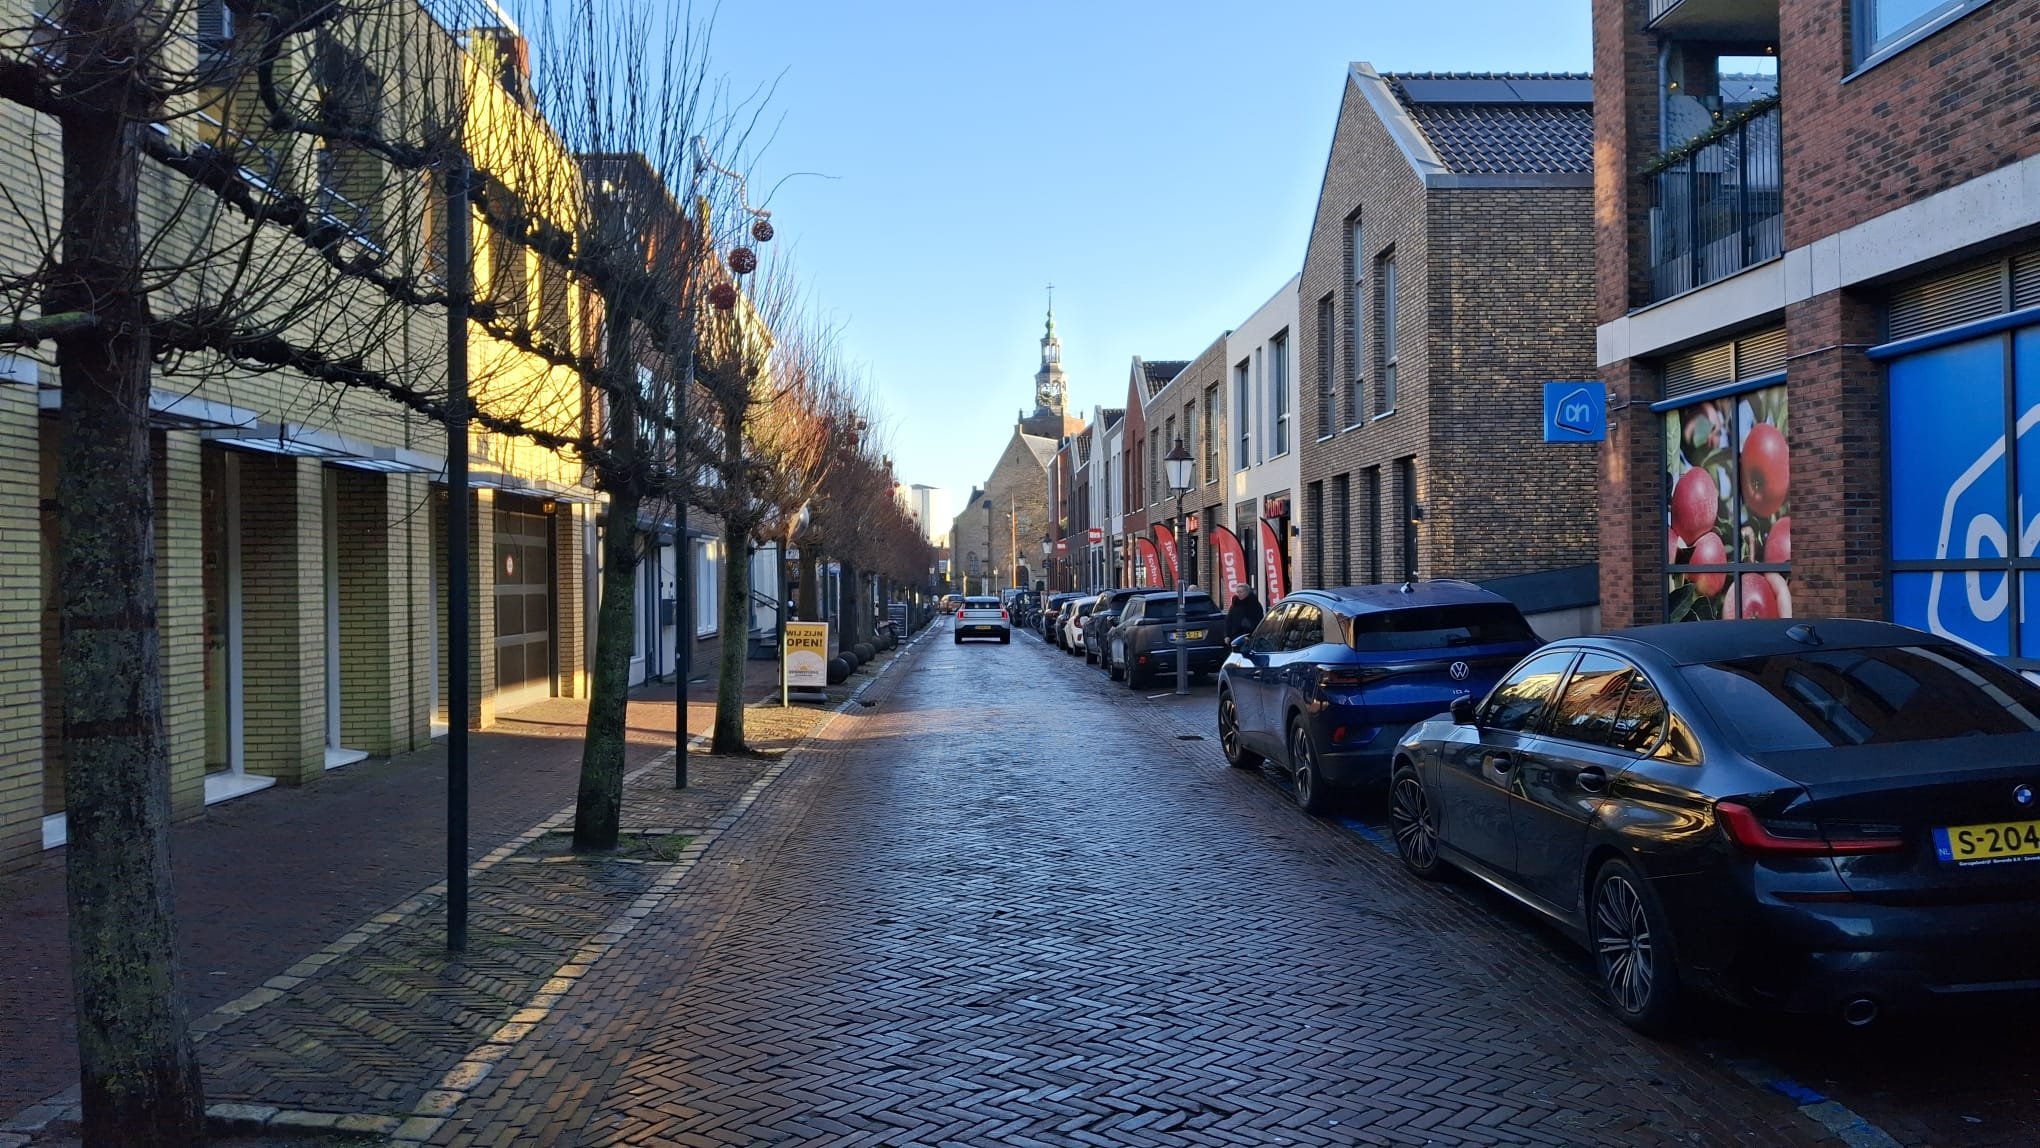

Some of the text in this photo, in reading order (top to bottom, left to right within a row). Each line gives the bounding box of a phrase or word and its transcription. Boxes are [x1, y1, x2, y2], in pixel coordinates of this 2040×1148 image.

[787, 639, 822, 647] OPEN!
[1958, 824, 2040, 855] S-204
[1939, 848, 1951, 857] NL
